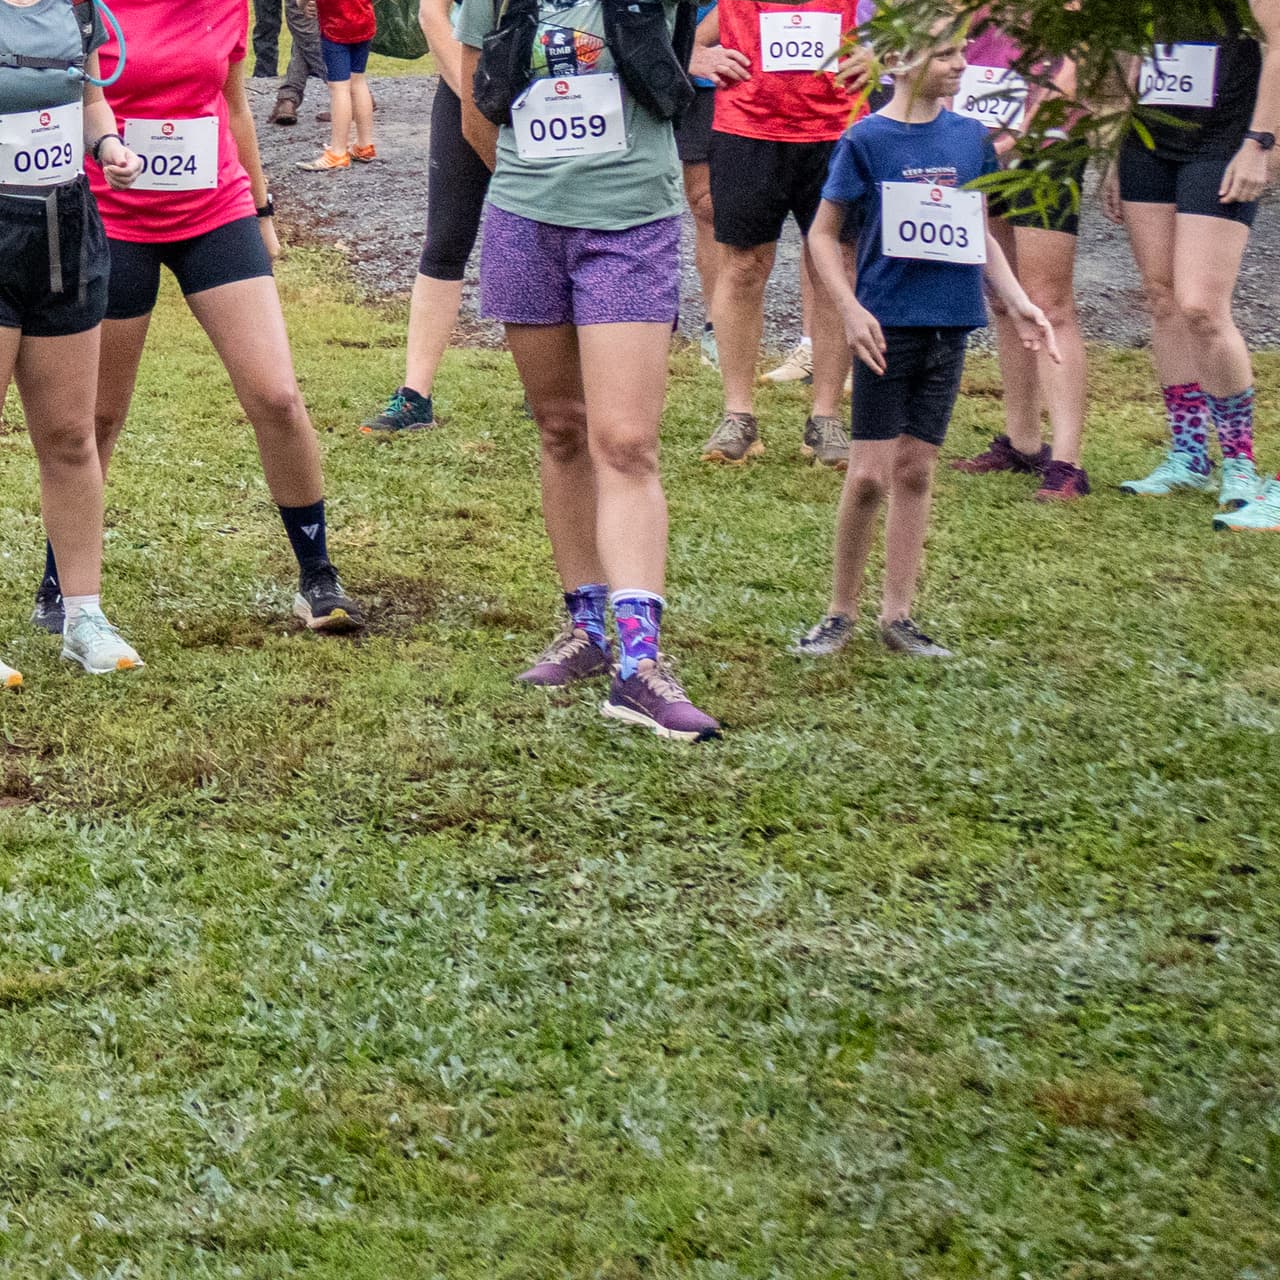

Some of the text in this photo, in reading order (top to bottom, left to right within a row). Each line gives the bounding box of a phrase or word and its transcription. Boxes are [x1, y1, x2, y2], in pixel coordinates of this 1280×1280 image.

[548, 46, 572, 57] RMB
[769, 41, 825, 59] 0028
[1145, 74, 1193, 93] 0026
[529, 114, 607, 142] 0059
[14, 142, 73, 173] 0029
[136, 153, 198, 176] 0024
[899, 220, 969, 248] 0003
